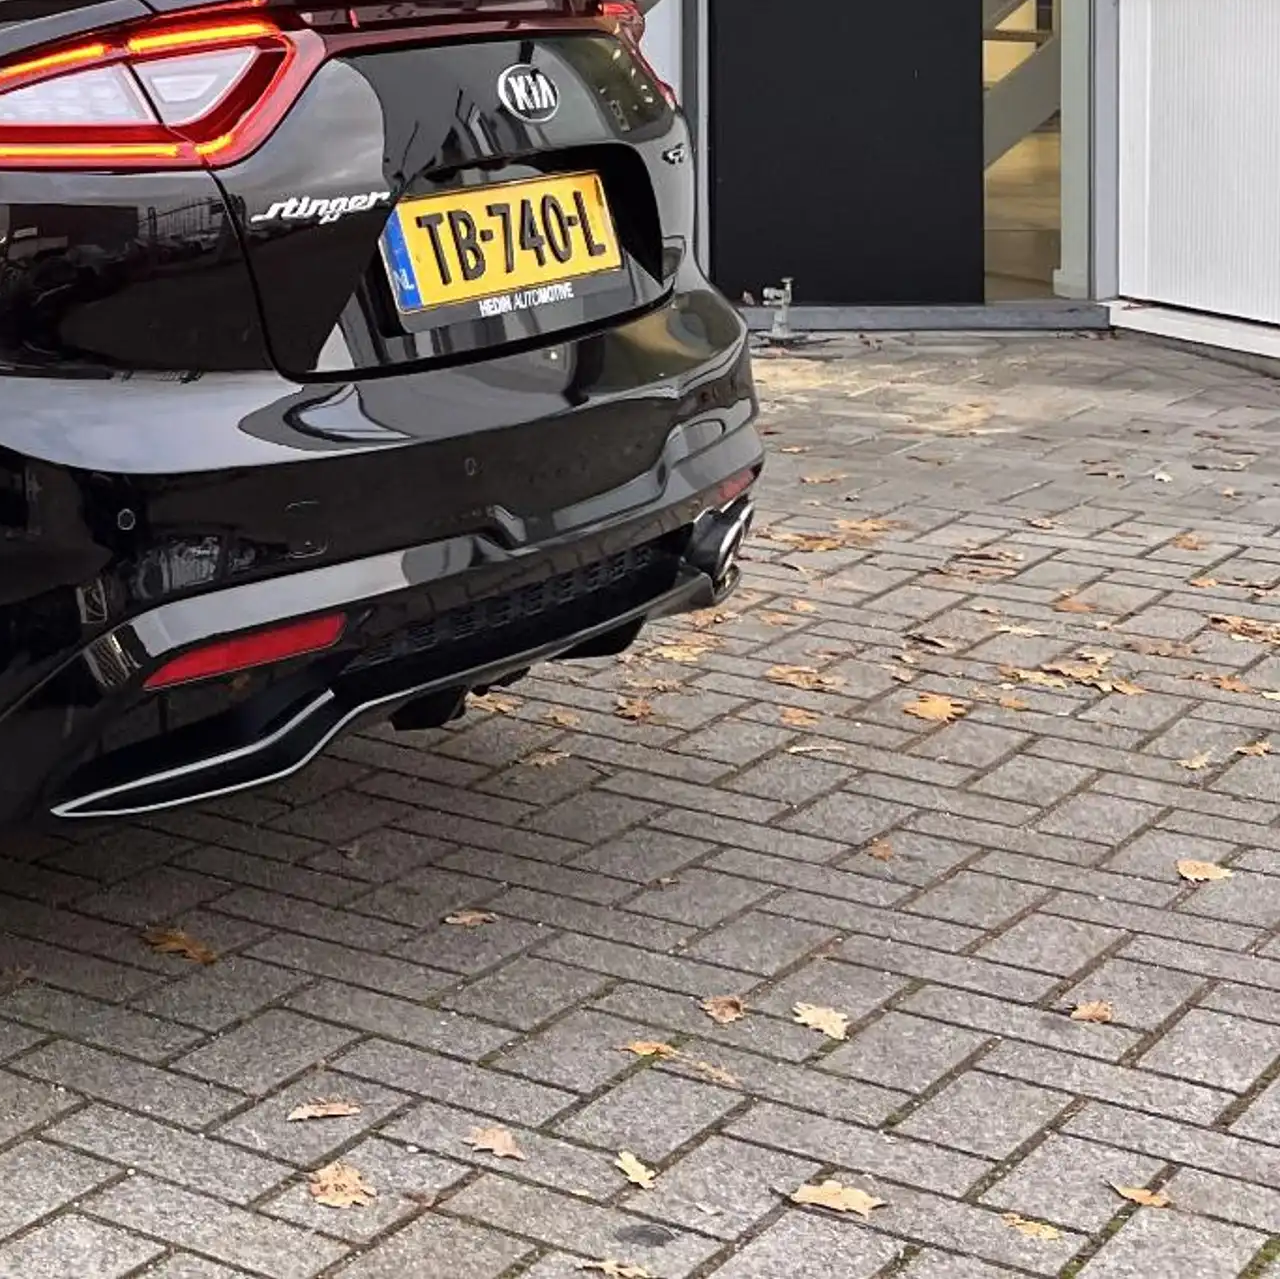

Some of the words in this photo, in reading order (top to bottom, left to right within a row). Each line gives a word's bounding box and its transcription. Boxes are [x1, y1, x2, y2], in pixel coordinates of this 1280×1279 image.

[392, 268, 415, 292] NL
[416, 190, 607, 286] TB-740-L
[513, 281, 574, 311] AUTOMOTIVE
